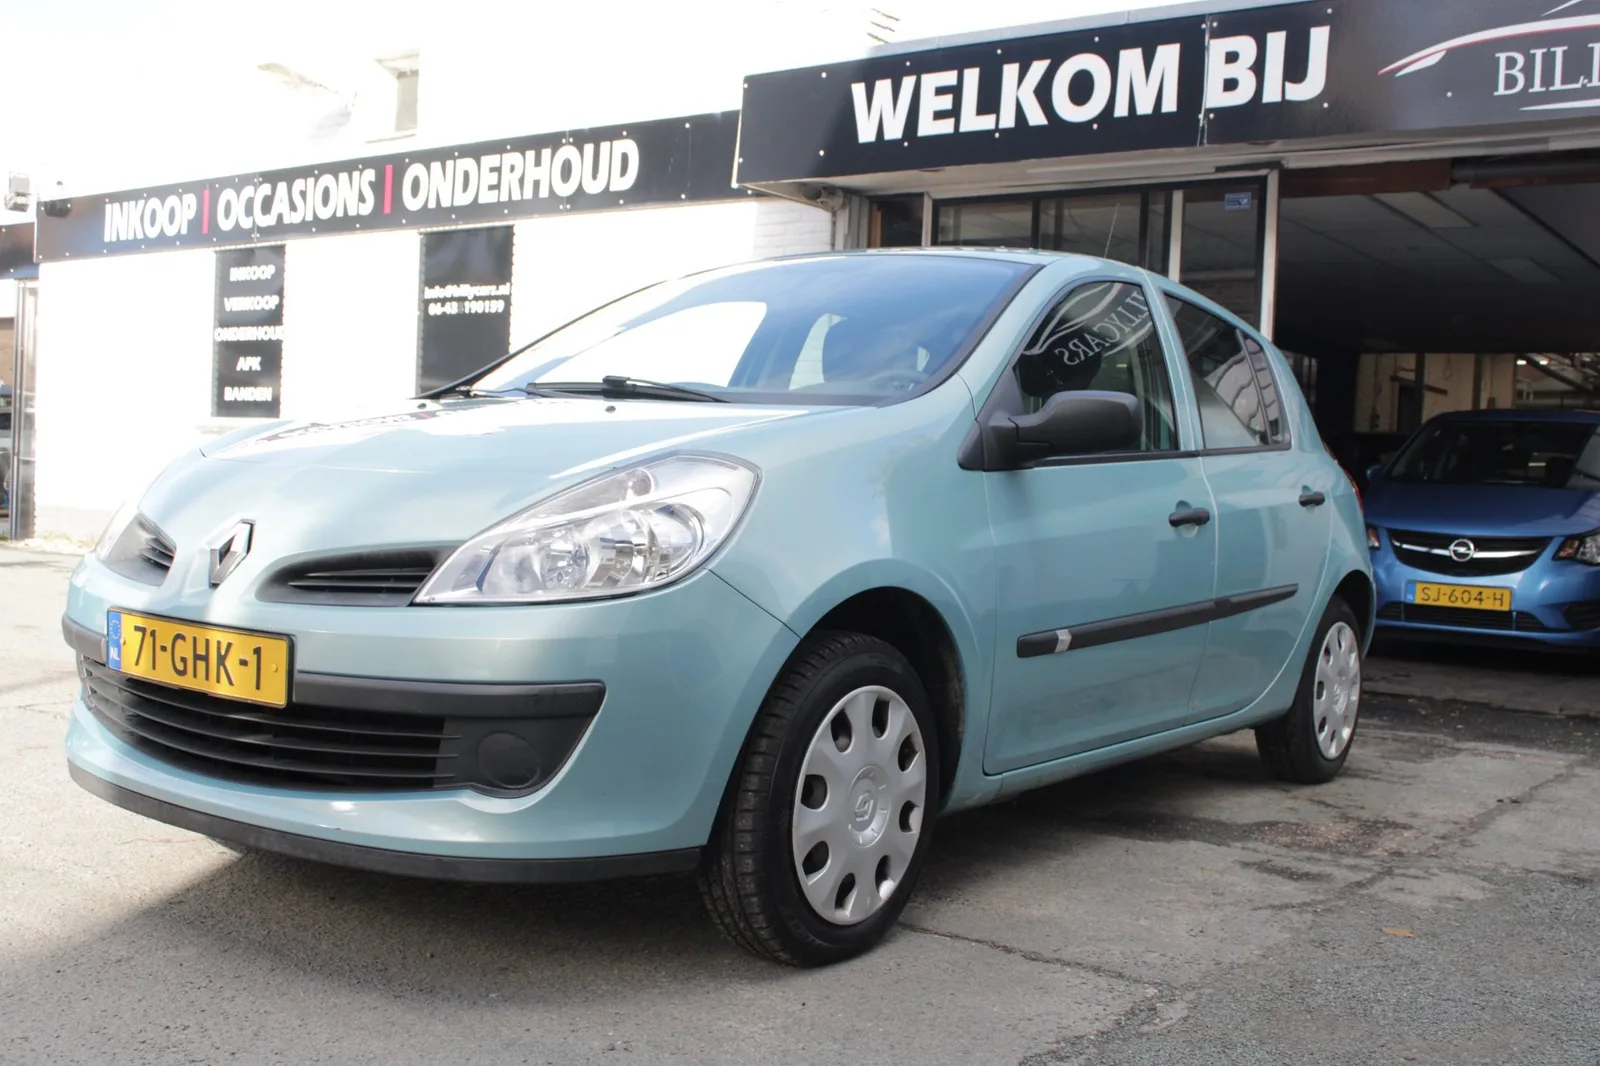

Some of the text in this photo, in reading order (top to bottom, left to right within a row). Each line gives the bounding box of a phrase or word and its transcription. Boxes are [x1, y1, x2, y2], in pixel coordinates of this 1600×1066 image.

[851, 25, 1331, 145] WELKOM BIJ
[103, 138, 639, 242] INKOOP OCCASIONS ONDERHOUD
[229, 264, 276, 281] INKOOP
[224, 295, 279, 312] VERKOOP
[236, 356, 262, 371] APK
[224, 386, 273, 402] BANDEN
[1421, 586, 1504, 607] SJ-604-H
[133, 625, 262, 690] 71-GHK-1
